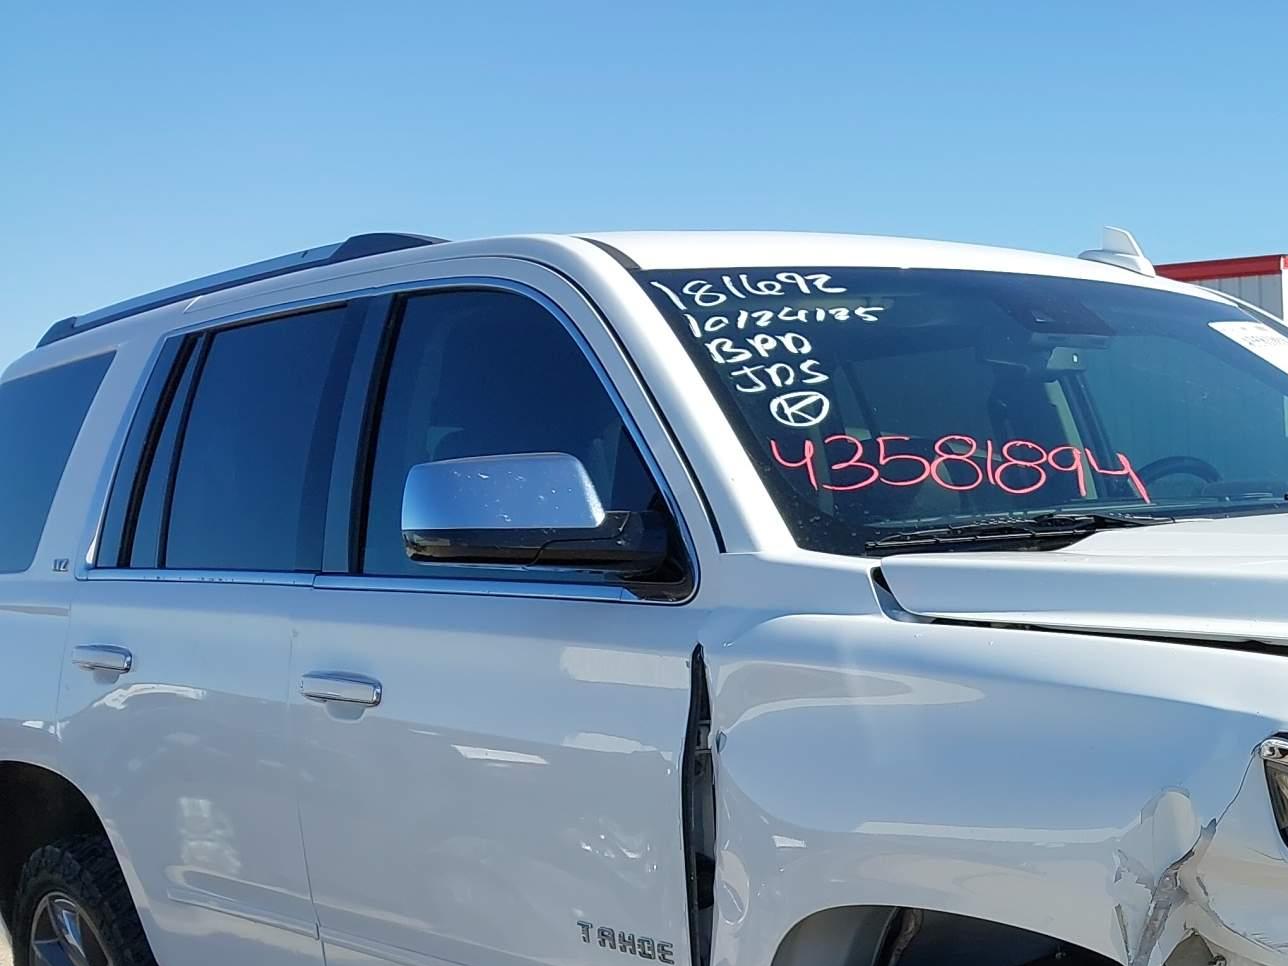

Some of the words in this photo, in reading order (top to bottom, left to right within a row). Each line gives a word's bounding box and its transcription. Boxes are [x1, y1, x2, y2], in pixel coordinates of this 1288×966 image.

[704, 332, 812, 364] BPD
[730, 359, 830, 393] JDS
[771, 434, 1150, 504] 43581894
[576, 920, 675, 966] TAHOE
